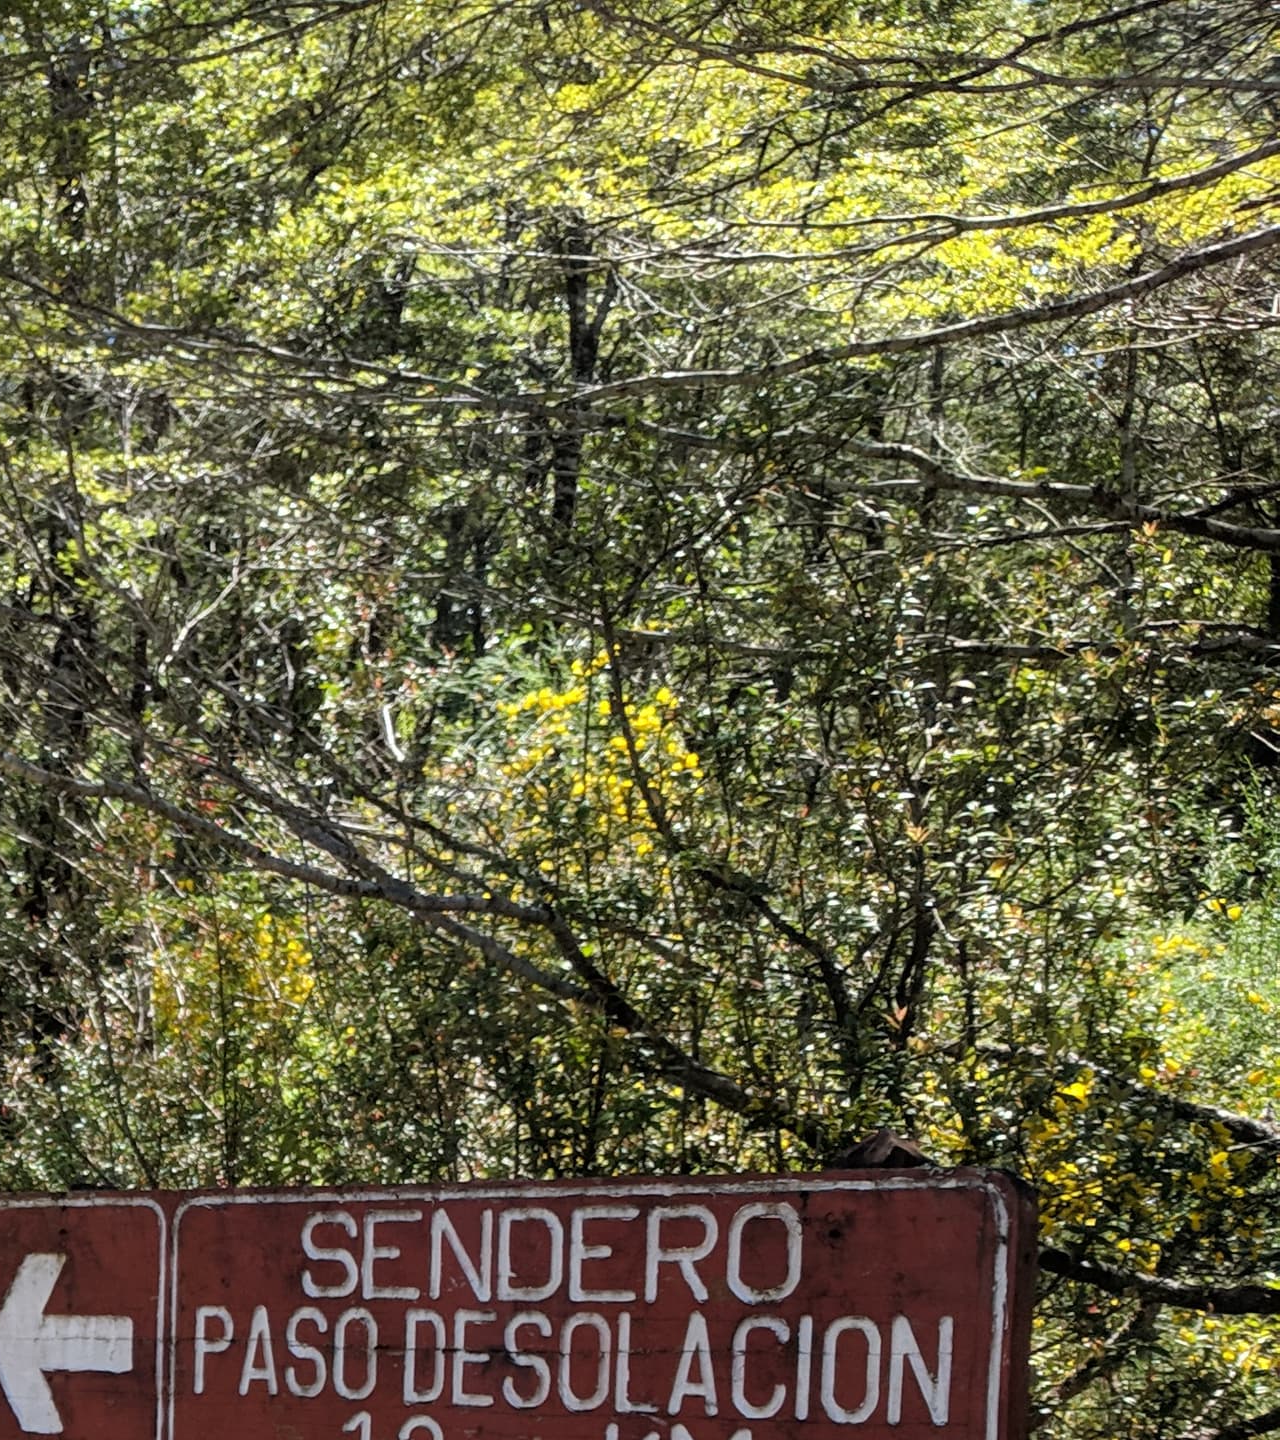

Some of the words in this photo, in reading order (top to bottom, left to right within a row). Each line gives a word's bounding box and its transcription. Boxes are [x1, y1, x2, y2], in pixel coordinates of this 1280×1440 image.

[300, 1202, 803, 1304] SENDERO
[193, 1305, 379, 1400] PASO
[403, 1307, 954, 1426] DESOLACION
